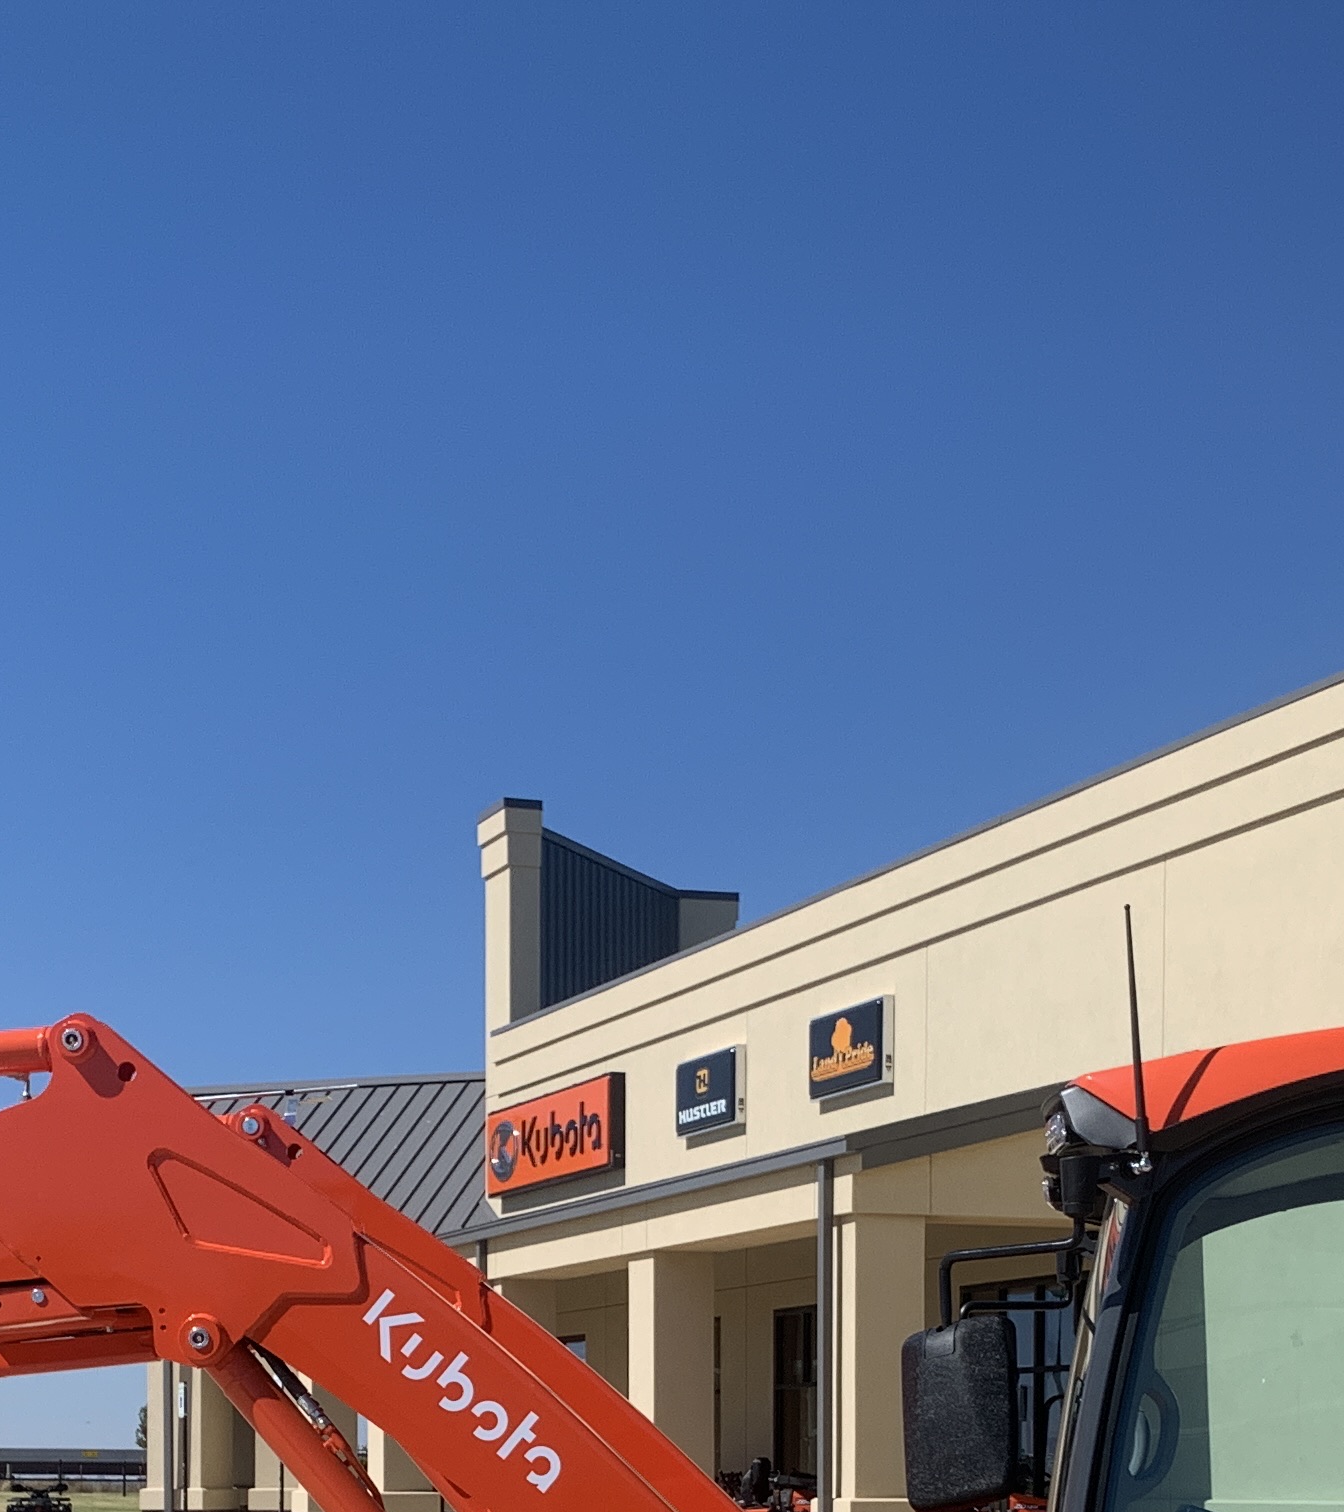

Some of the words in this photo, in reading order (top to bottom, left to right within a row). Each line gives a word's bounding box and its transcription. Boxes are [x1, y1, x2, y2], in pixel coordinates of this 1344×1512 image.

[520, 1101, 602, 1168] Kubota
[678, 1098, 727, 1125] HUSTLER
[362, 1288, 562, 1494] Kubota
